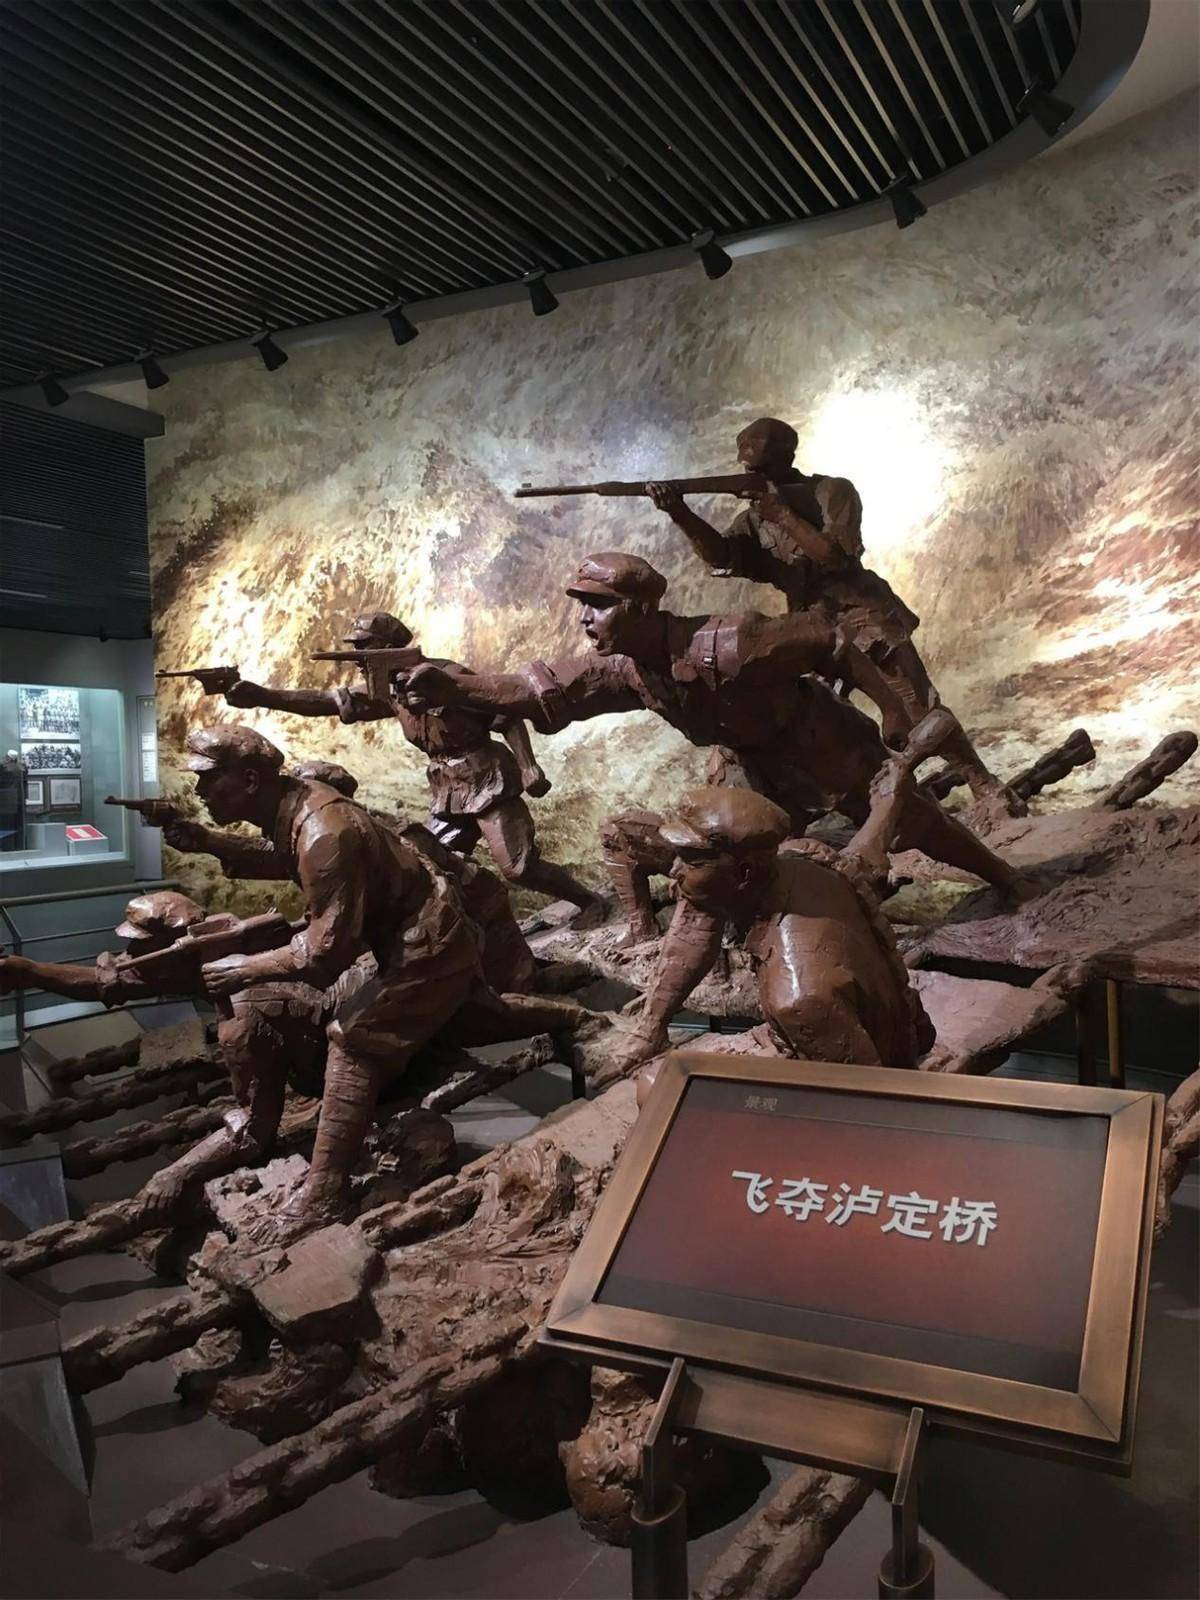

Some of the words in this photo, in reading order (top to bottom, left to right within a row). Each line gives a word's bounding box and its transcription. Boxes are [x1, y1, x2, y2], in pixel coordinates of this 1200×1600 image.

[731, 1170, 998, 1246] 飞夺泸定桥
